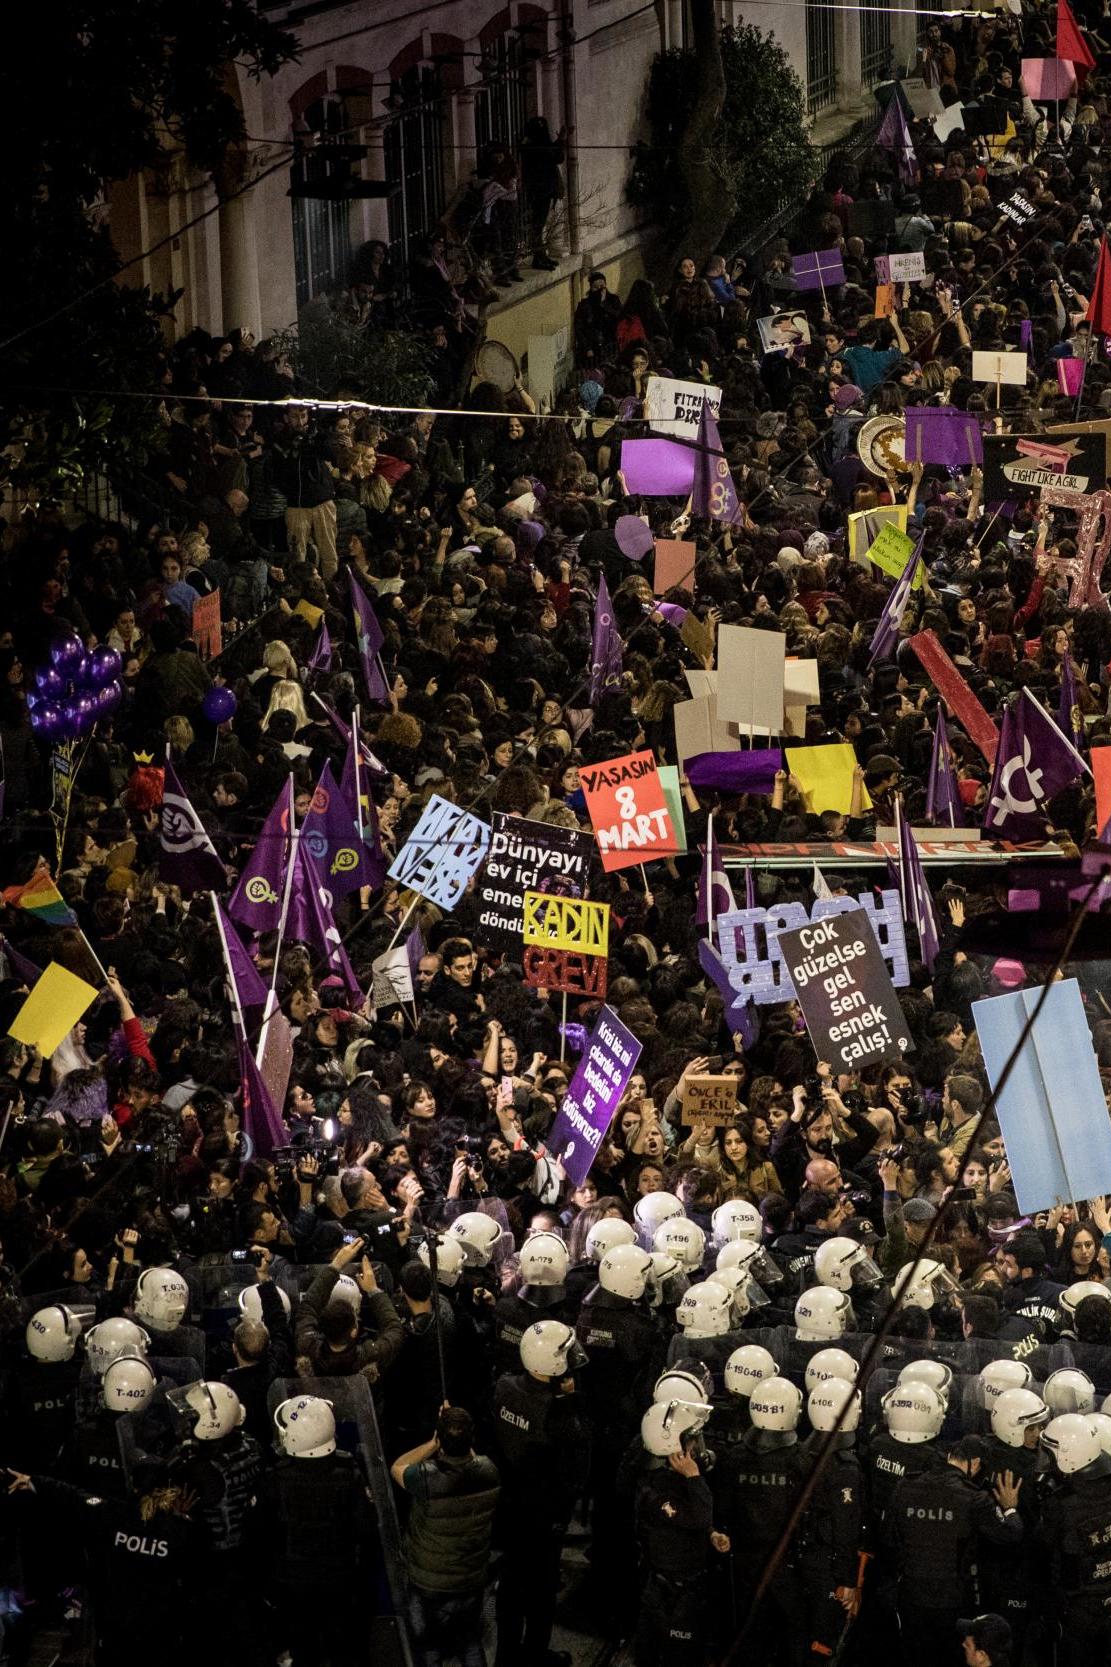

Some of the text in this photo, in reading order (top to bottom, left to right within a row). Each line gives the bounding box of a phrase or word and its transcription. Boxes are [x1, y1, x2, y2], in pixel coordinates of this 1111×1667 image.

[1012, 469, 1038, 482] FIGHT
[1037, 472, 1054, 485] LIKE
[614, 786, 637, 820] 8
[597, 808, 669, 854] MART
[491, 832, 583, 874] Dünyayı
[487, 862, 538, 889] ev içi
[524, 893, 610, 946] KADIN
[800, 920, 839, 960] Çok
[793, 938, 867, 987] güzelse
[823, 969, 856, 1003] gel
[830, 989, 866, 1017] sen
[828, 1004, 888, 1042] esnek
[597, 1021, 616, 1048] Krizi
[611, 1035, 623, 1058] biz
[840, 1024, 893, 1068] çalış!
[582, 1089, 597, 1115] biz
[666, 1234, 689, 1243] T-196
[34, 1399, 65, 1412] POL
[116, 1388, 145, 1399] T-402
[89, 1456, 120, 1469] POL
[738, 1473, 787, 1486] POLİS
[907, 1506, 954, 1521] POLİS
